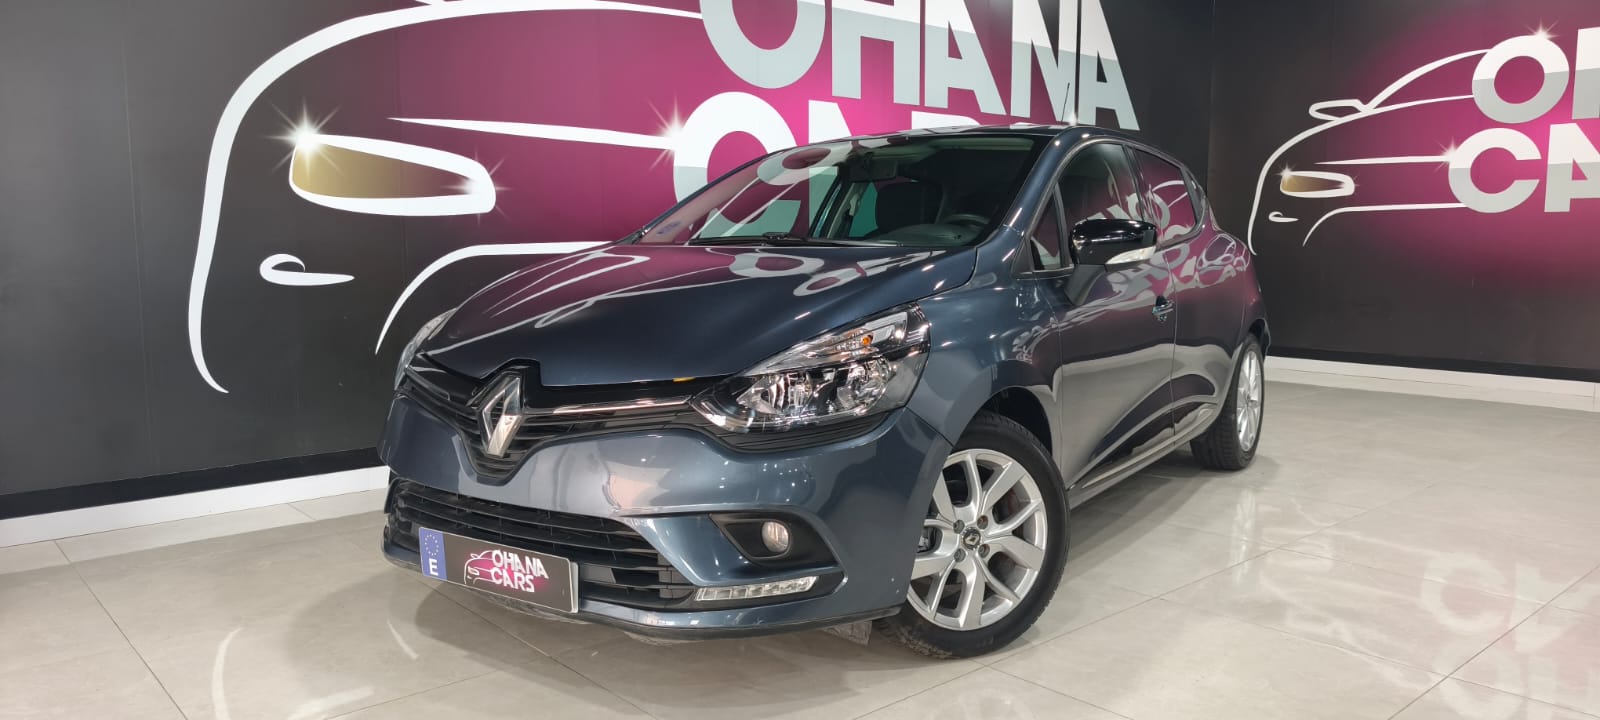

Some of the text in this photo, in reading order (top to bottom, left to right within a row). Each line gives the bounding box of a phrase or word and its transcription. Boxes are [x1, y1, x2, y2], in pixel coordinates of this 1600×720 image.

[701, 0, 1140, 131] OHANA
[429, 558, 439, 576] E
[491, 549, 549, 579] OHANA
[490, 566, 535, 593] CARS
